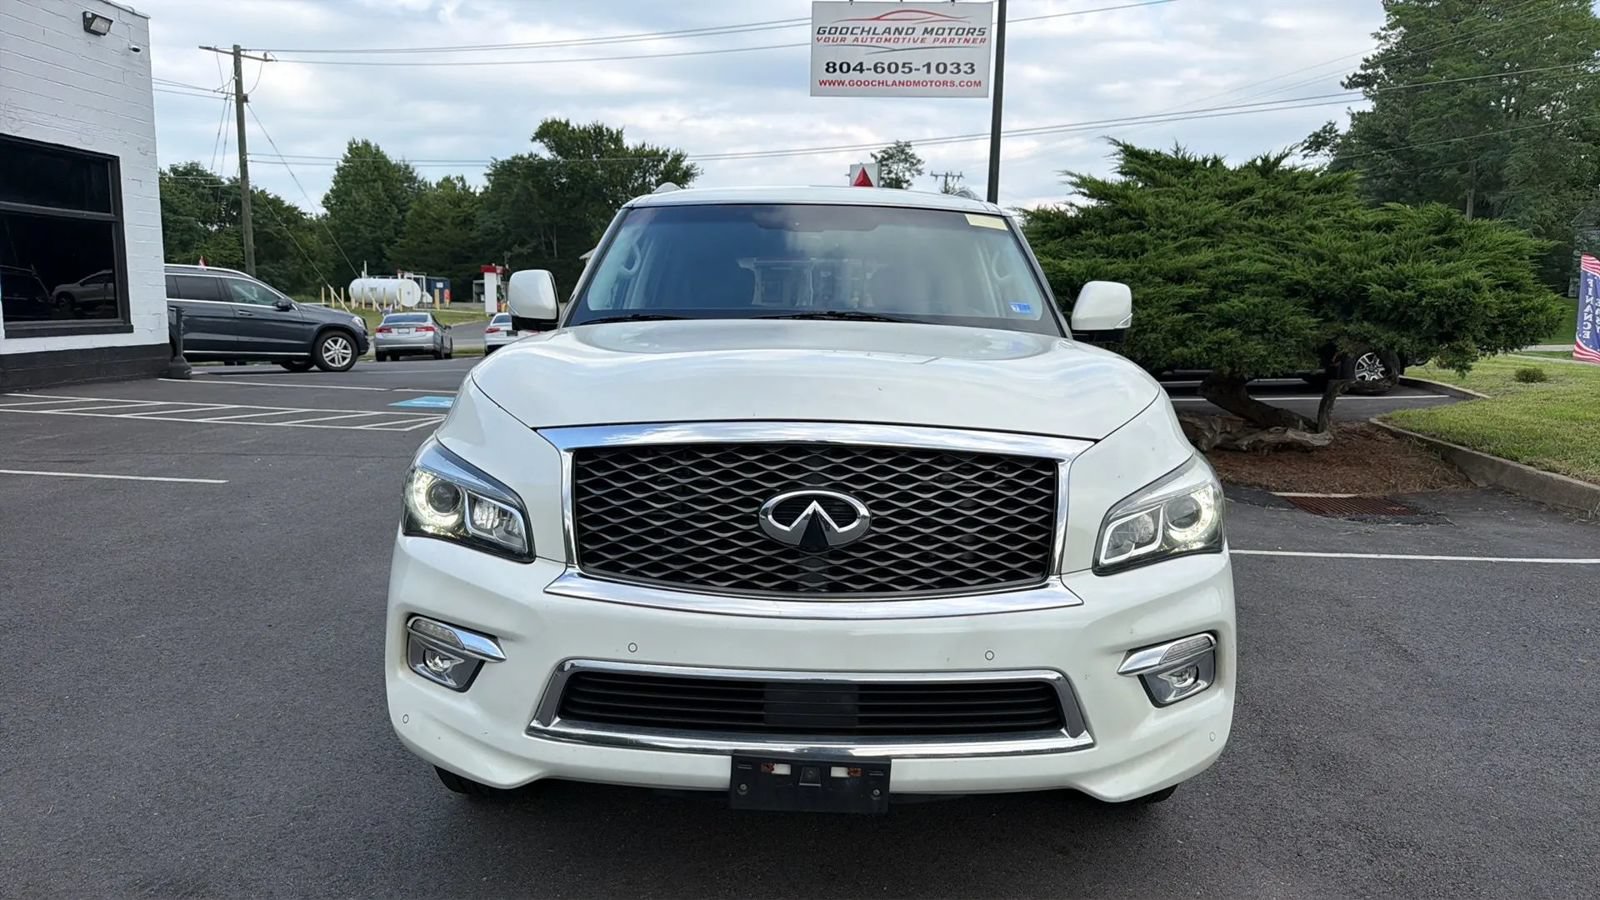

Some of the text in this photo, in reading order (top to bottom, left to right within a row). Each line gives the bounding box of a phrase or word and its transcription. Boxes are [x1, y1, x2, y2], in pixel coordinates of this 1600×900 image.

[816, 26, 987, 36] GOOCHLAND MOTORS
[816, 36, 987, 45] YOUR AUTOMOTIVE PARTNER
[825, 61, 976, 75] 804-605-1033
[818, 79, 982, 88] WWW.GOOCHLANDMOTORS.COM
